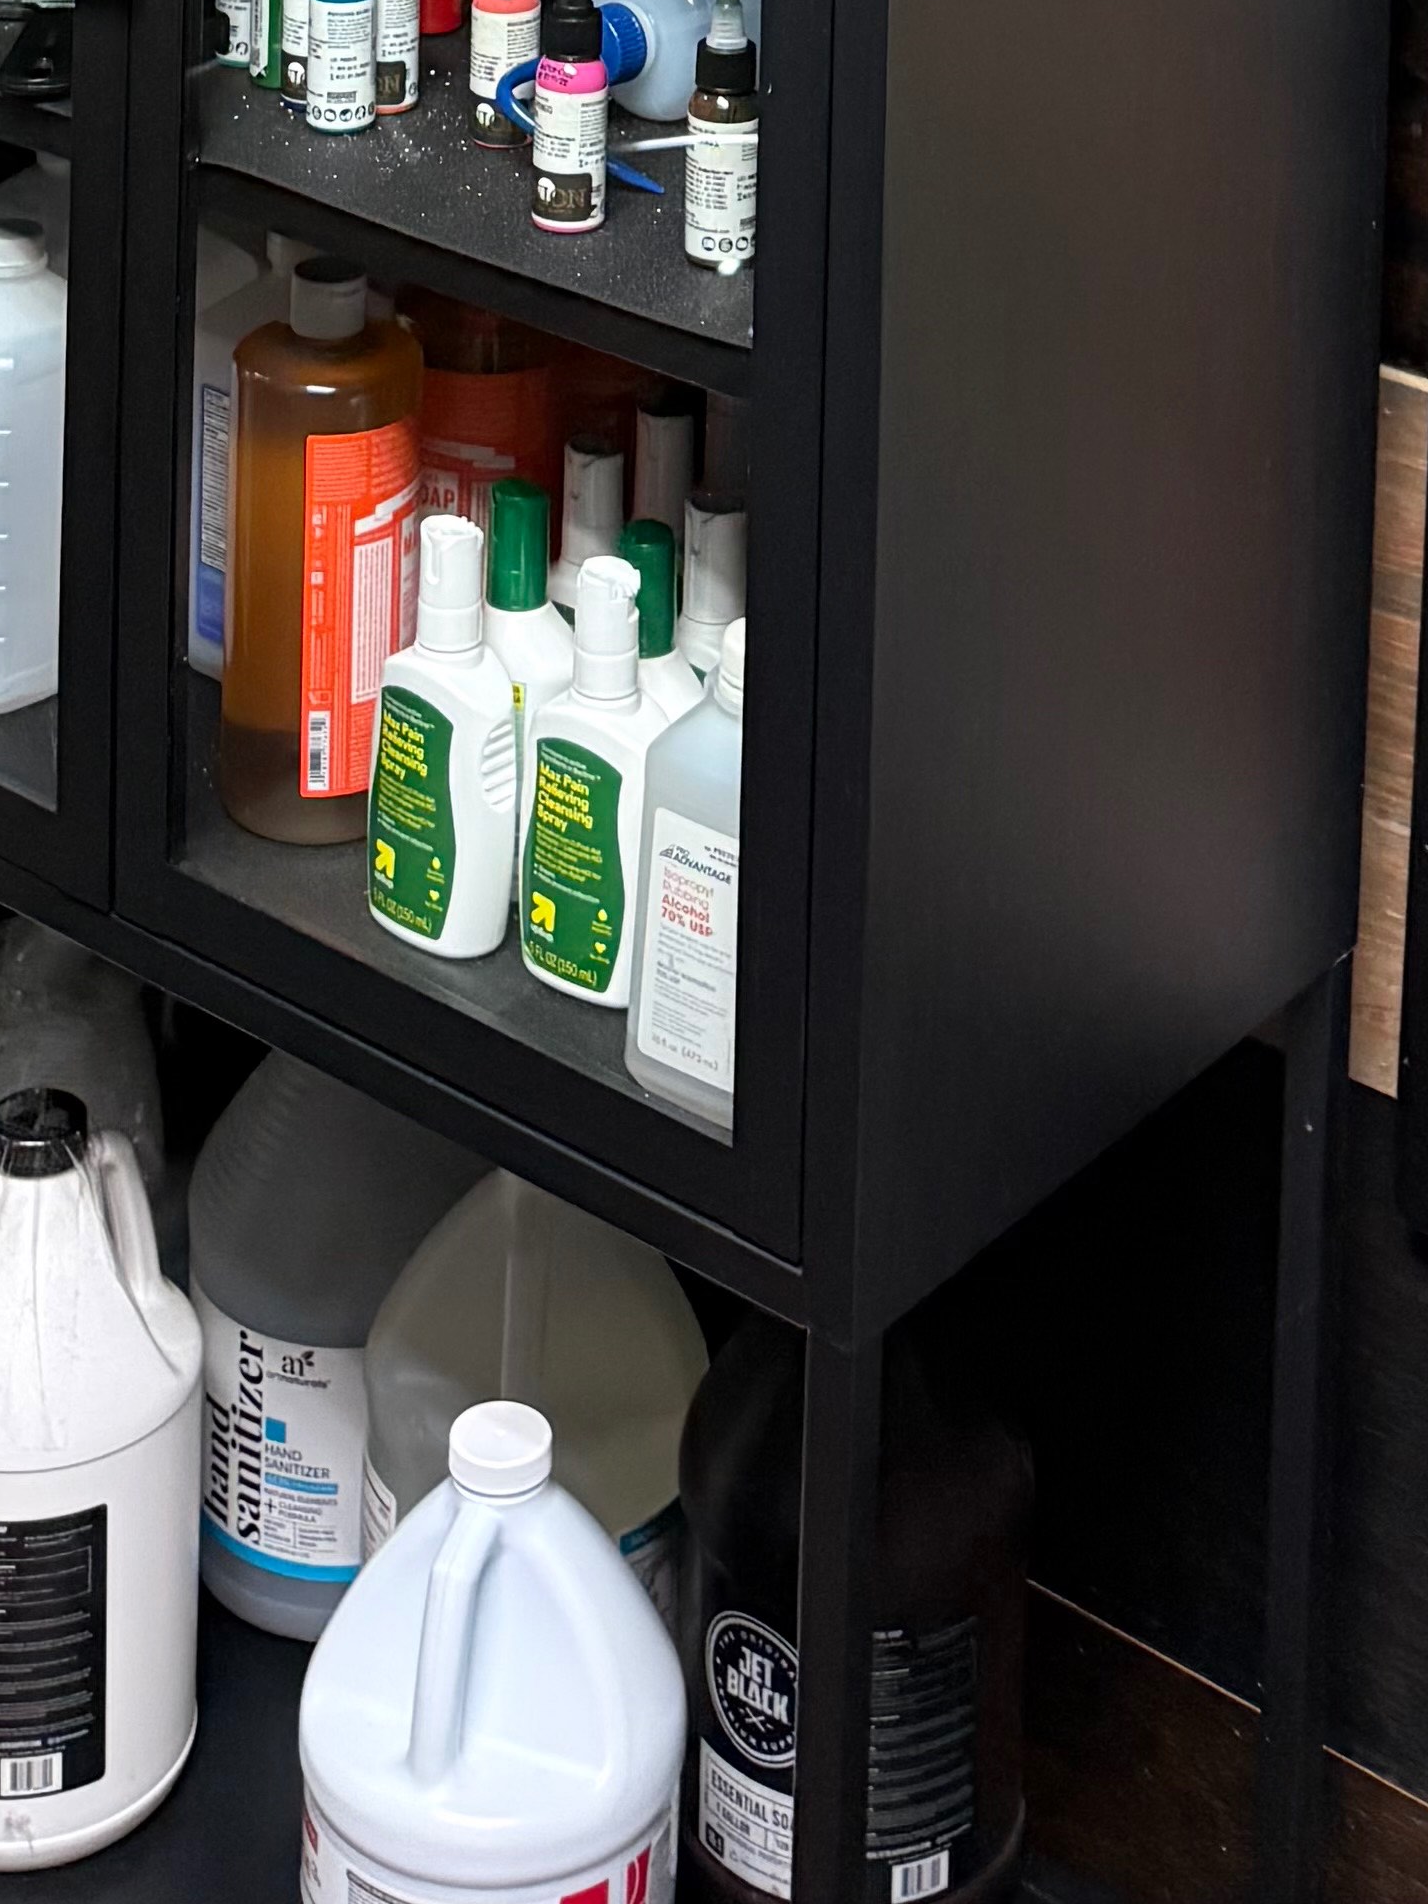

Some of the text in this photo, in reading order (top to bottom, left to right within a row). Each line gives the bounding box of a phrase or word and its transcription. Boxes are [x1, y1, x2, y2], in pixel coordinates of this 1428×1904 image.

[400, 721, 425, 745] Pain
[539, 759, 590, 797] Max Pain
[537, 790, 594, 830] Cleansing
[673, 853, 732, 885] ADVANTAGE
[661, 905, 686, 928] 70%
[662, 893, 710, 924] Alcohol
[534, 945, 544, 962] FL
[545, 950, 557, 968] OZ
[231, 1329, 264, 1546] sanitizer
[264, 1443, 303, 1462] HAND
[204, 1391, 231, 1527] hand
[264, 1456, 331, 1480] SANITIZER
[738, 1645, 775, 1689] JET
[726, 1664, 790, 1726] BLACK
[711, 1767, 768, 1823] ESSENTIAL
